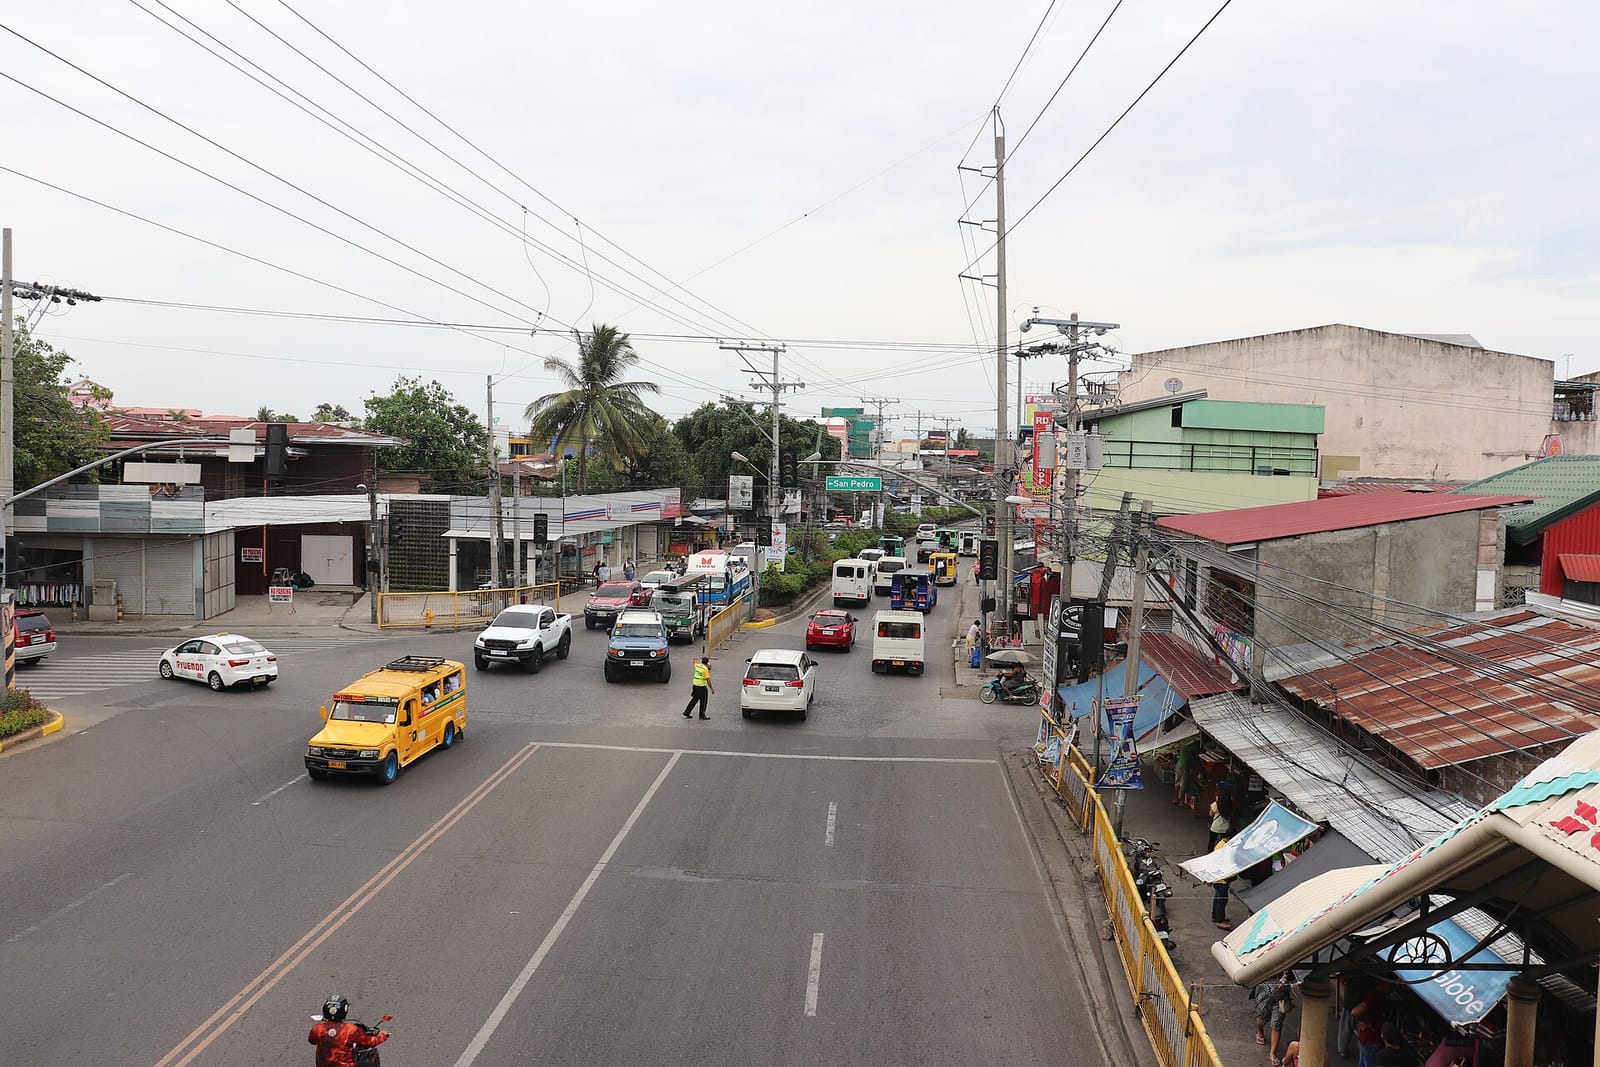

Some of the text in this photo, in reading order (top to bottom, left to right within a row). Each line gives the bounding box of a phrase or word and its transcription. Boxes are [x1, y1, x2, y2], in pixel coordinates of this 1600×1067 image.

[1035, 416, 1049, 425] RD
[833, 479, 874, 488] San Pedro
[1431, 968, 1485, 1015] Globe
